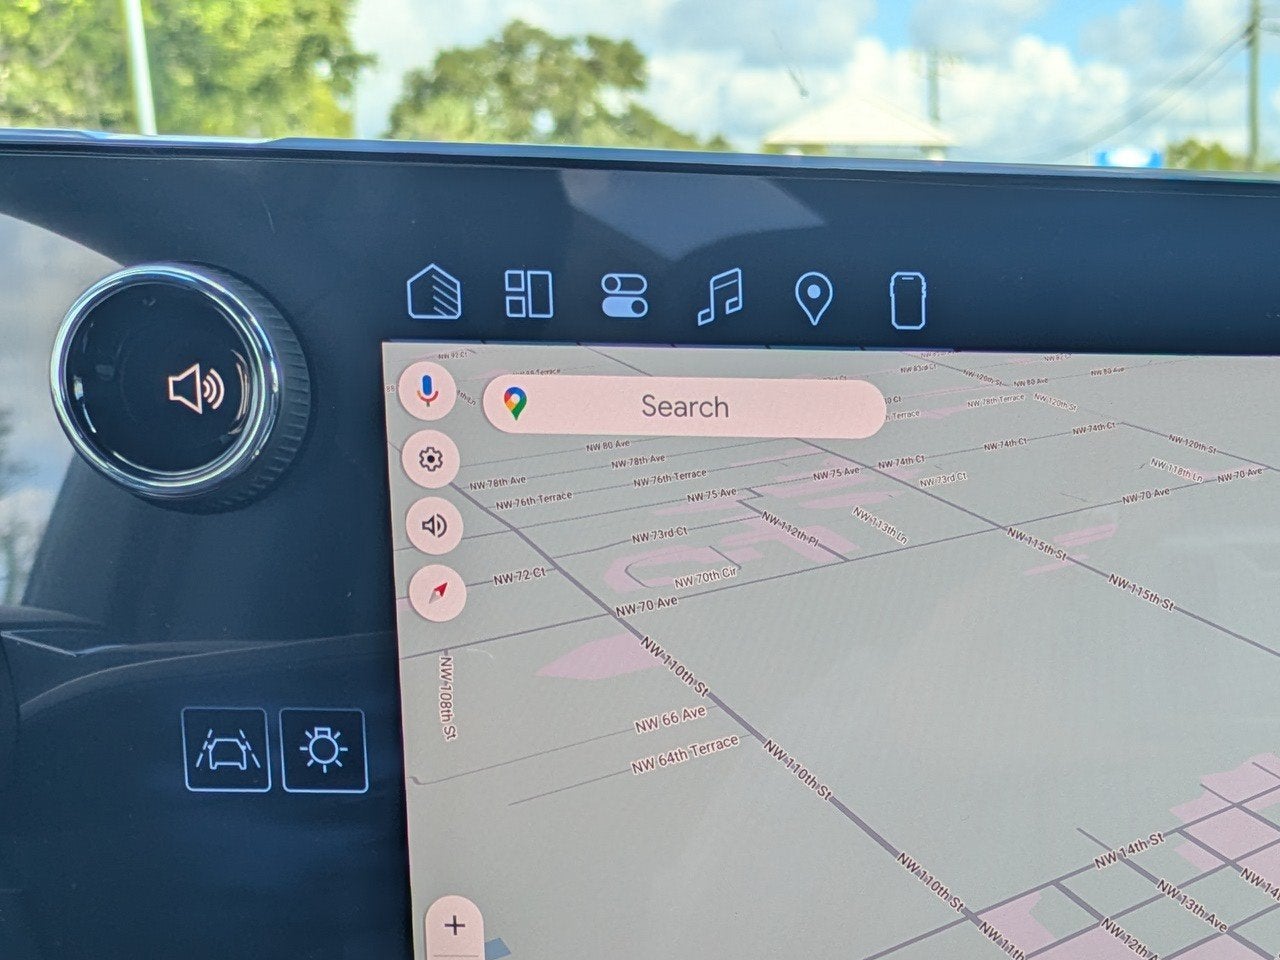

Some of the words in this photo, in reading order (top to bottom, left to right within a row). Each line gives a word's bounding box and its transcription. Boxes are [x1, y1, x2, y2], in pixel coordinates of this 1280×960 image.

[641, 394, 729, 418] Search
[611, 461, 626, 469] NW
[629, 457, 648, 466] 78th
[650, 454, 665, 463] Ave
[1151, 458, 1166, 469] NW
[1169, 465, 1190, 477] 118th
[1192, 472, 1203, 481] Ln
[470, 482, 485, 490] NW
[488, 479, 508, 488] 78th
[510, 476, 526, 484] Ave
[634, 478, 649, 487] NW
[651, 474, 672, 484] 76th
[673, 469, 707, 480] Terrace
[496, 500, 512, 510] NW
[514, 496, 536, 507] 76th
[538, 490, 572, 504] Terrace
[687, 494, 703, 503] NW
[706, 491, 717, 499] 75
[720, 488, 737, 497] Ave
[1122, 495, 1139, 504] NW
[1141, 491, 1151, 500] 70
[1153, 488, 1170, 498] Ave
[632, 534, 649, 543] NW
[651, 529, 674, 540] 73rd
[676, 526, 688, 536] Ct
[1007, 527, 1025, 542] NW
[1026, 535, 1054, 555] 115th
[1054, 548, 1067, 562] St
[494, 575, 512, 585] NW
[516, 571, 530, 581] 72
[533, 568, 546, 578] Ct
[674, 577, 694, 589] NW
[697, 571, 722, 584] 70th
[723, 567, 738, 578] Cir
[1109, 574, 1128, 589] NW
[1130, 583, 1160, 604] 115th
[1160, 598, 1175, 611] St
[616, 605, 638, 618] NW
[640, 601, 654, 612] 70
[657, 595, 678, 608] Ave
[440, 657, 452, 682] NW
[641, 636, 664, 657] NW
[662, 654, 696, 685] 110th
[694, 681, 710, 697] St
[440, 685, 453, 724] 108th
[635, 718, 659, 734] NW
[662, 713, 679, 726] 66
[682, 706, 706, 721] Ave
[444, 725, 457, 740] St
[631, 759, 655, 774] NW
[658, 749, 688, 766] 64th
[690, 735, 739, 756] Terrace
[764, 739, 788, 762] NW
[786, 758, 819, 789] 110th
[816, 785, 832, 801] St
[1094, 854, 1116, 868] NW
[1119, 842, 1147, 858] 14th
[1149, 833, 1164, 846] St
[897, 852, 921, 875] NW
[919, 870, 951, 901] 110th
[949, 898, 965, 913] St
[1240, 868, 1263, 886] NW
[1157, 880, 1180, 900] NW
[1180, 892, 1205, 917] 13th
[1204, 912, 1228, 932] Ave
[978, 921, 1002, 944] NW
[1102, 918, 1124, 938] NW
[1123, 931, 1150, 955] 12th
